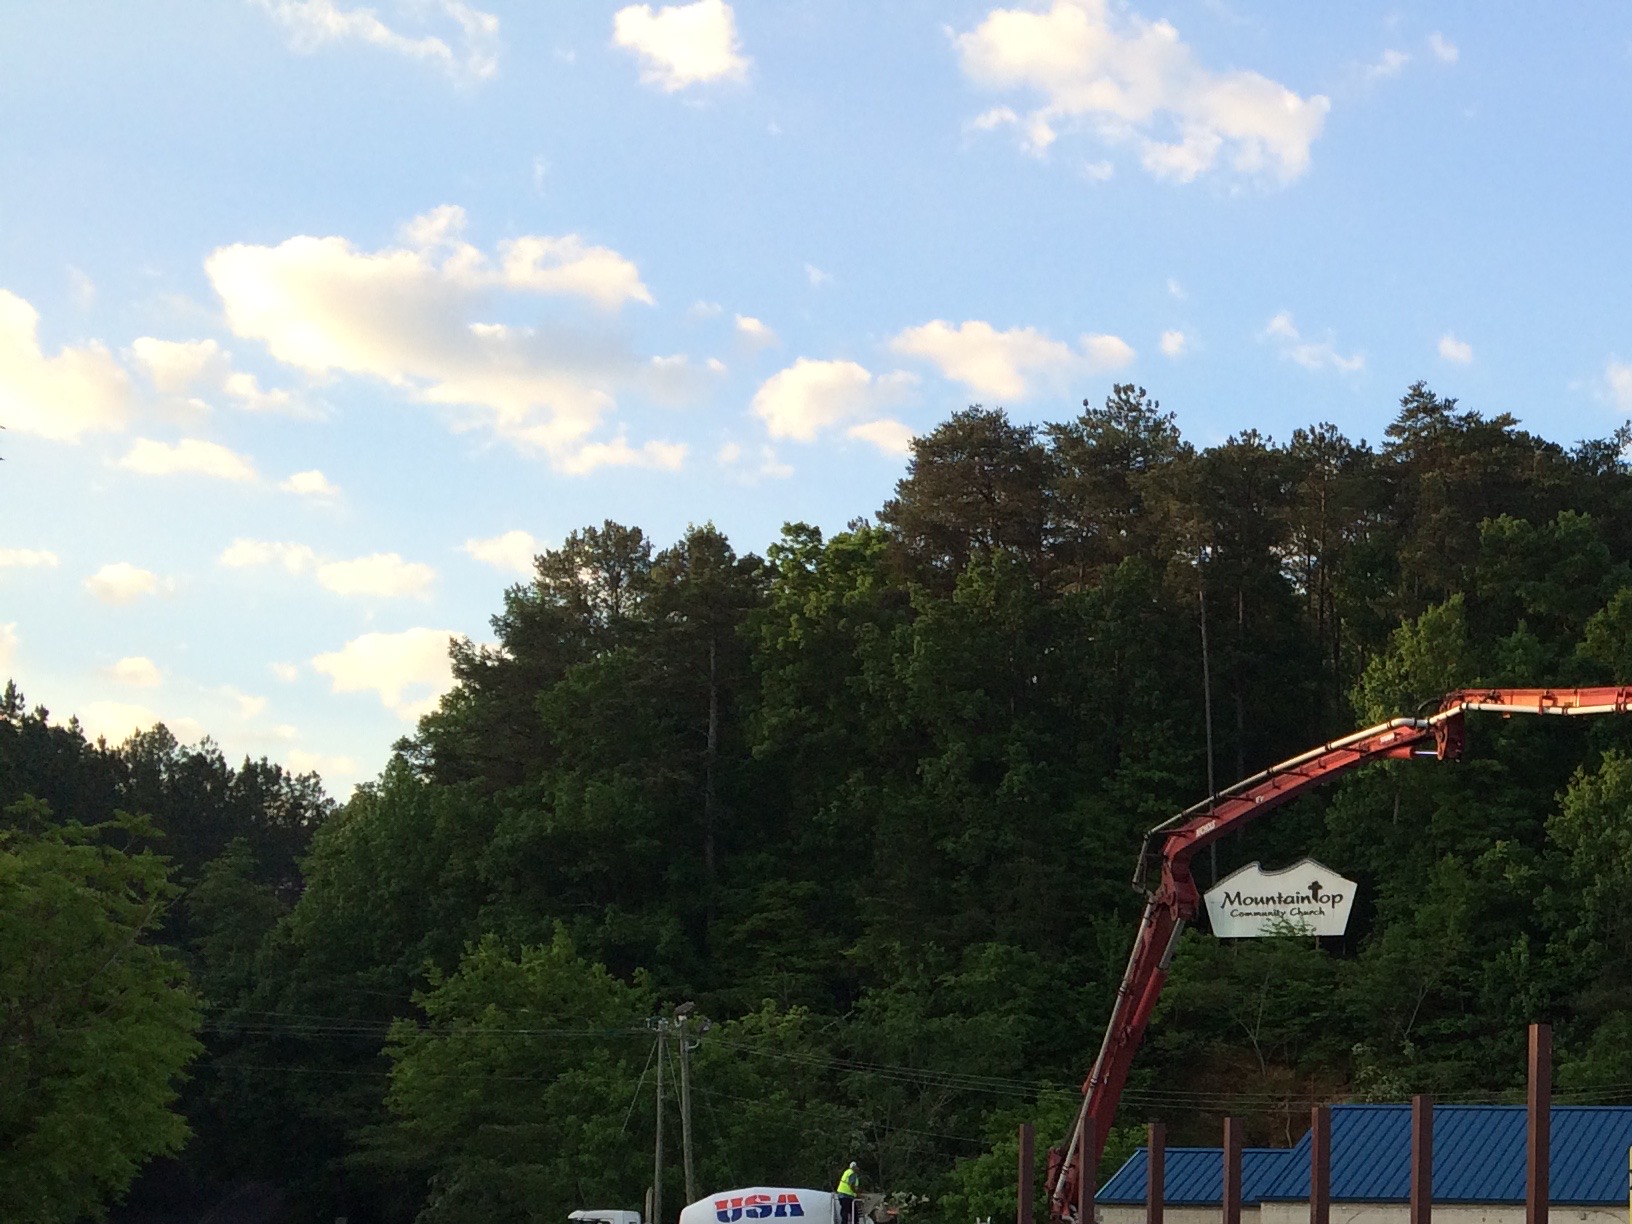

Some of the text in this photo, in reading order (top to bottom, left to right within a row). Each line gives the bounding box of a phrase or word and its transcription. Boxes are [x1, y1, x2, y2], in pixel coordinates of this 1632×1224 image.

[1230, 907, 1326, 918] Community Church
[715, 1194, 805, 1223] USA
